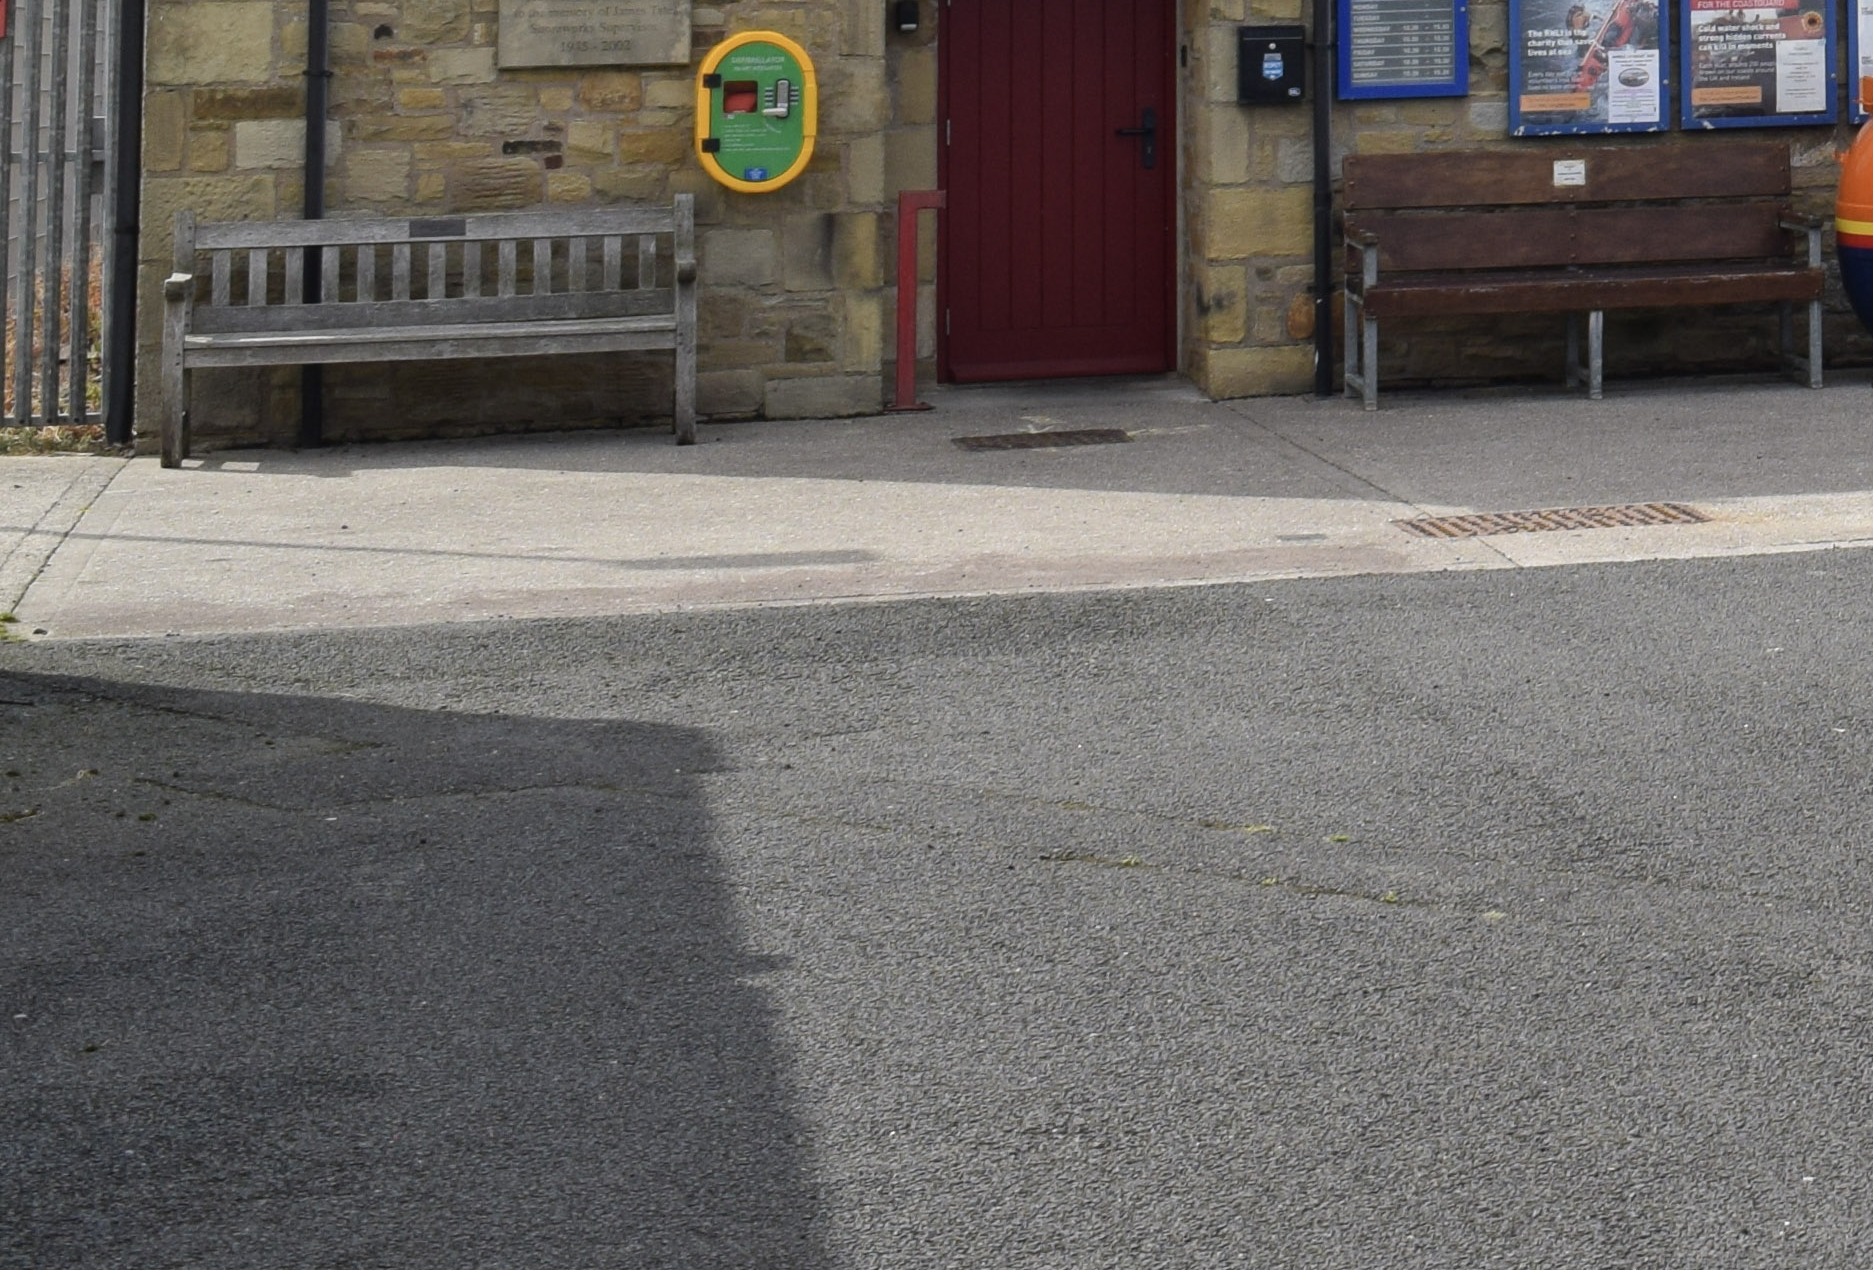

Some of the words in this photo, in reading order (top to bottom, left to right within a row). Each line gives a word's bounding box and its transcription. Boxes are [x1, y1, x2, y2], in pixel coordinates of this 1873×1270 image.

[1733, 0, 1784, 7] COASTGUARD
[601, 40, 632, 51] 2002
[1528, 39, 1556, 47] charity
